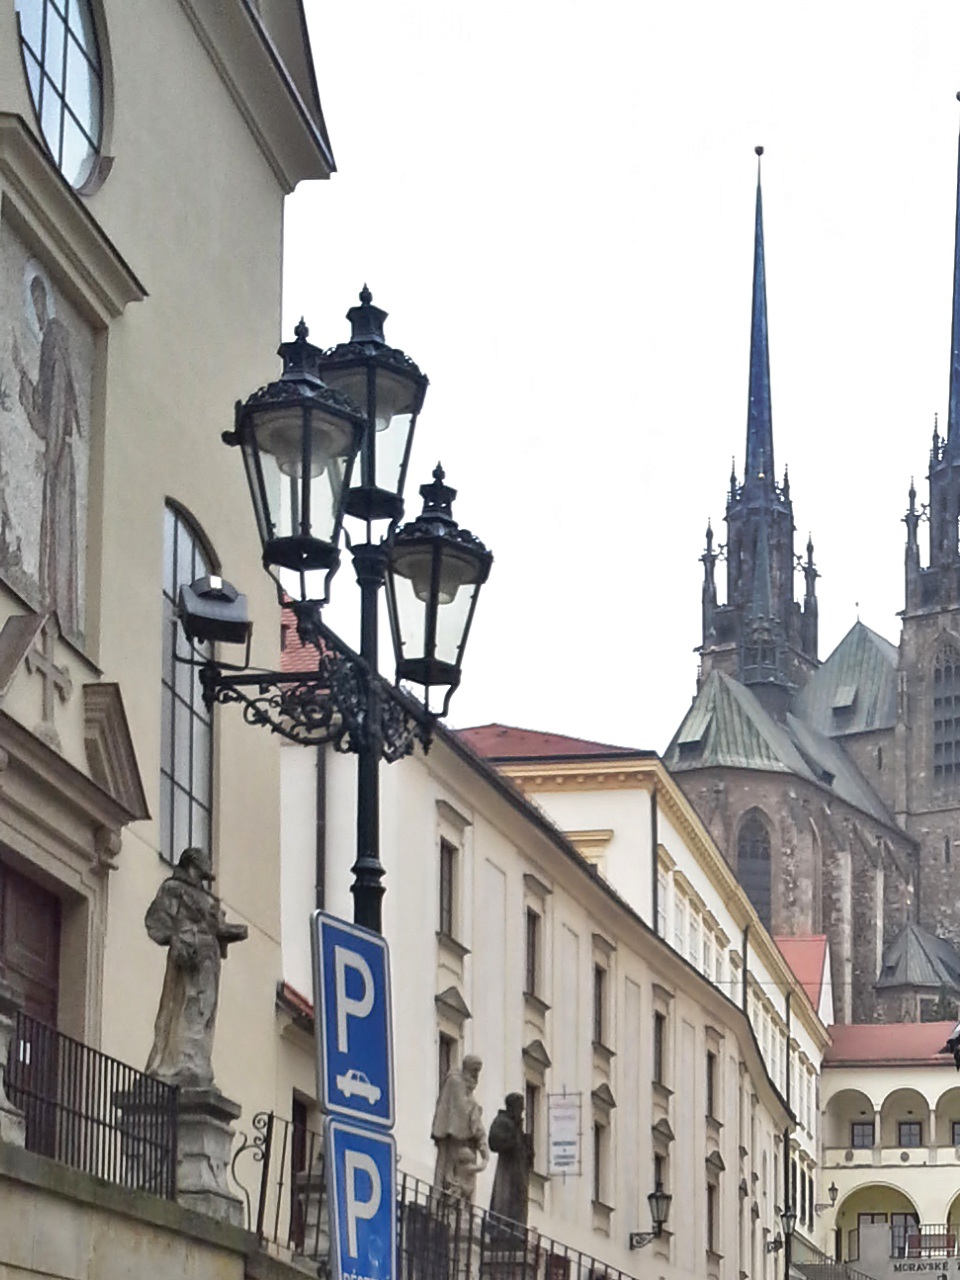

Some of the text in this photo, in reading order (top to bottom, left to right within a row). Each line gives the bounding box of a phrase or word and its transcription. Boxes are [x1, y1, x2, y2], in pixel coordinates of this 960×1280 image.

[335, 945, 375, 1053] P
[344, 1150, 382, 1259] P
[893, 1261, 949, 1272] MORAVSKÉ
